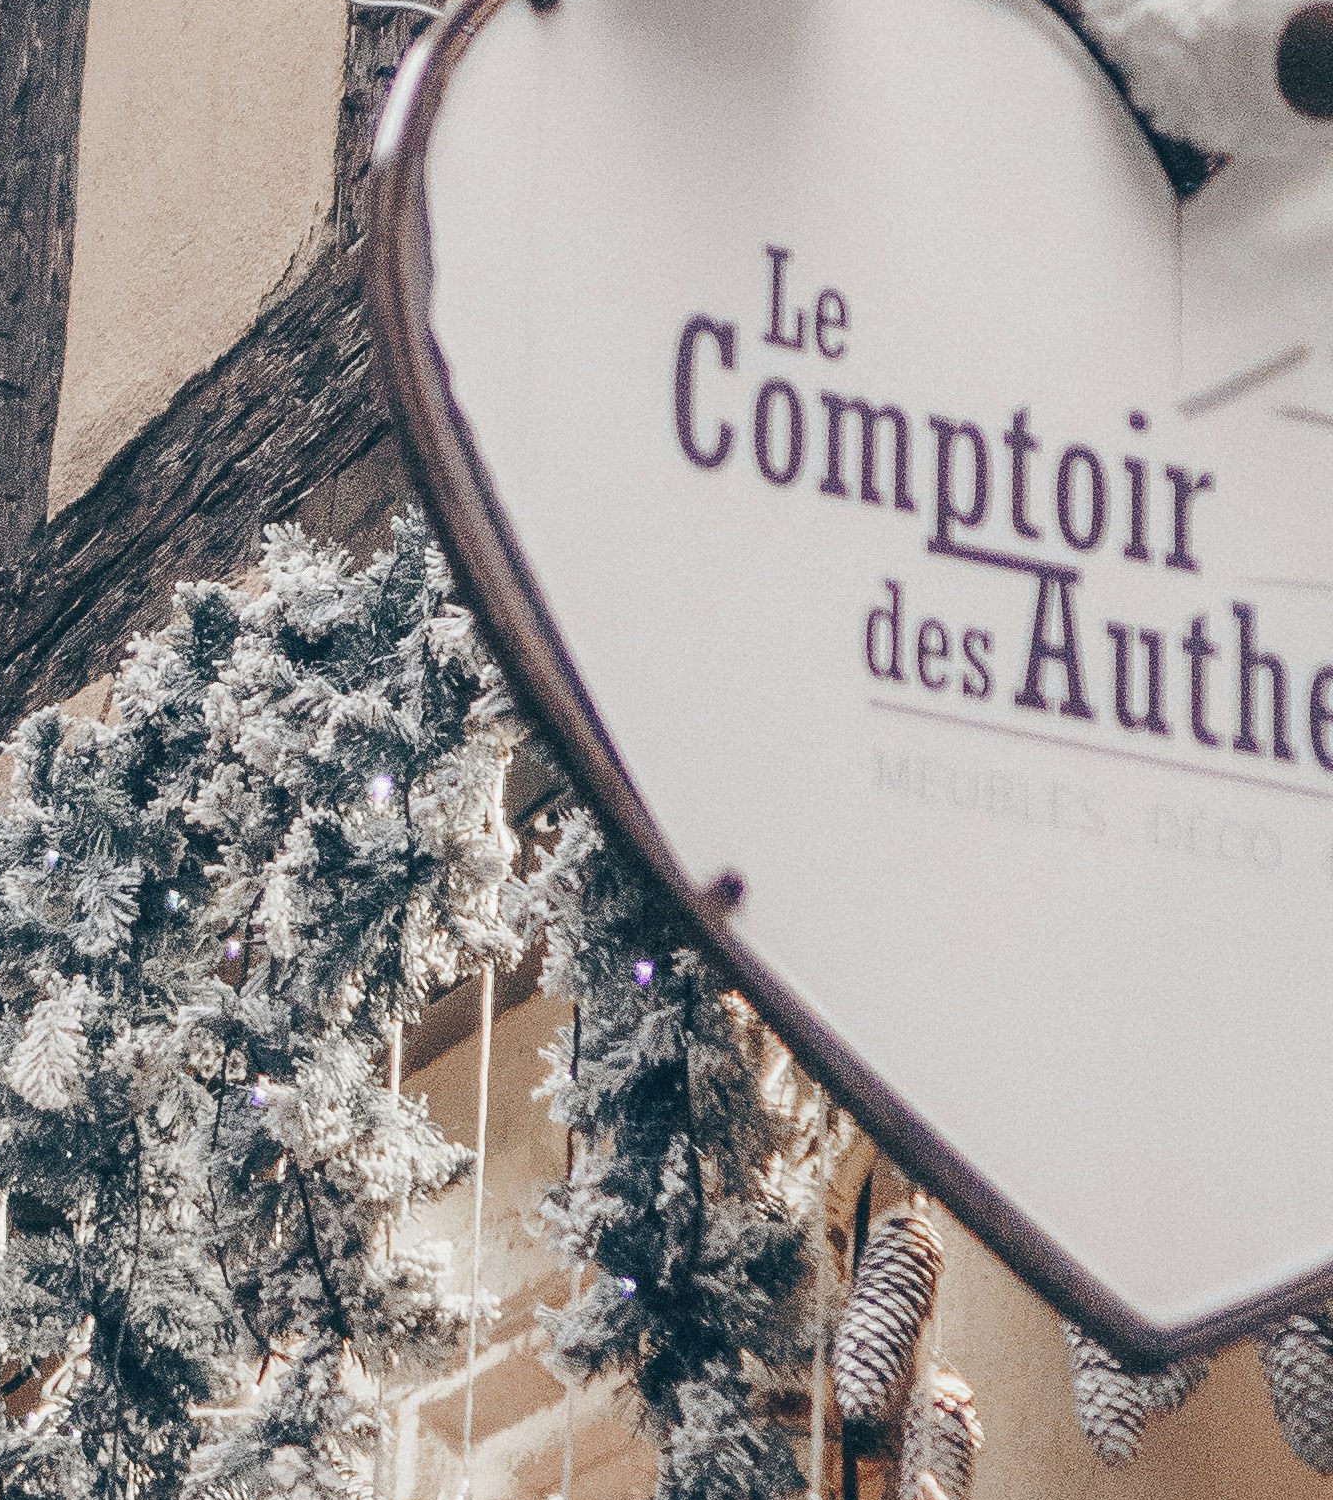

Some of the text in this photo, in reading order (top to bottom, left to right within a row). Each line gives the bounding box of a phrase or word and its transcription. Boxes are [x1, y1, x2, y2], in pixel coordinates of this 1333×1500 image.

[764, 243, 851, 360] Le
[672, 313, 1215, 572] Comptoir
[864, 578, 996, 700] des
